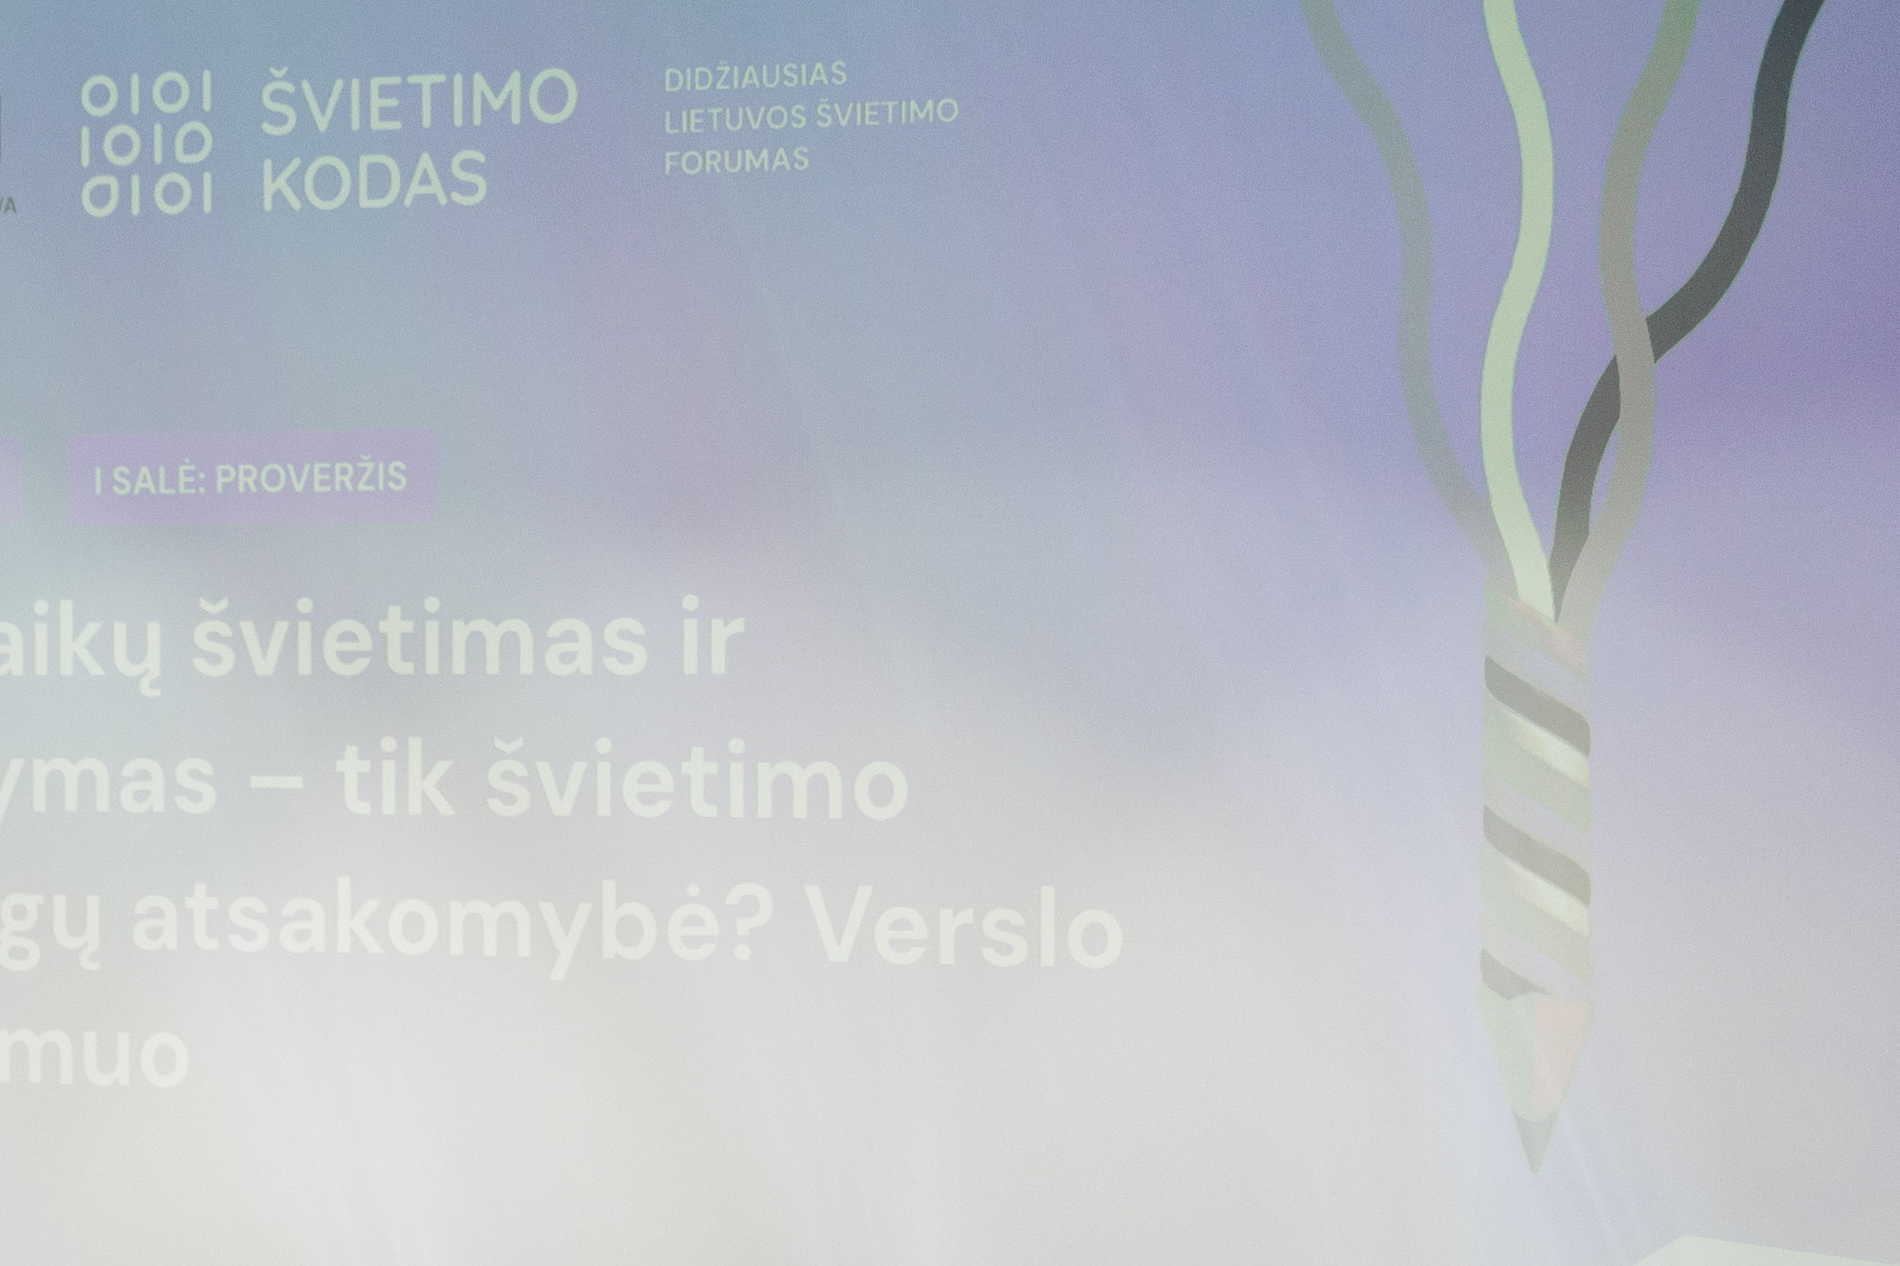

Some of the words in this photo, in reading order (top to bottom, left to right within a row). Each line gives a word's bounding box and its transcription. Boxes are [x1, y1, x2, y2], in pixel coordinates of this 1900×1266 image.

[260, 66, 579, 136] ŠVIETIMO
[664, 60, 848, 92] DIDŽIAUSIAS
[664, 104, 807, 134] LIETUVOS
[816, 97, 959, 128] ŠVIETIMO
[262, 150, 488, 213] KODAS
[664, 147, 809, 176] FORUMAS
[112, 457, 206, 496] SALĖ:
[216, 454, 408, 493] PROVERŽIS
[190, 595, 649, 677] švietimas
[682, 594, 747, 676] ir
[335, 736, 457, 818] tik
[486, 736, 910, 821] švietimo
[130, 876, 776, 982] atsakomybė?
[804, 883, 1125, 970] Verslo
